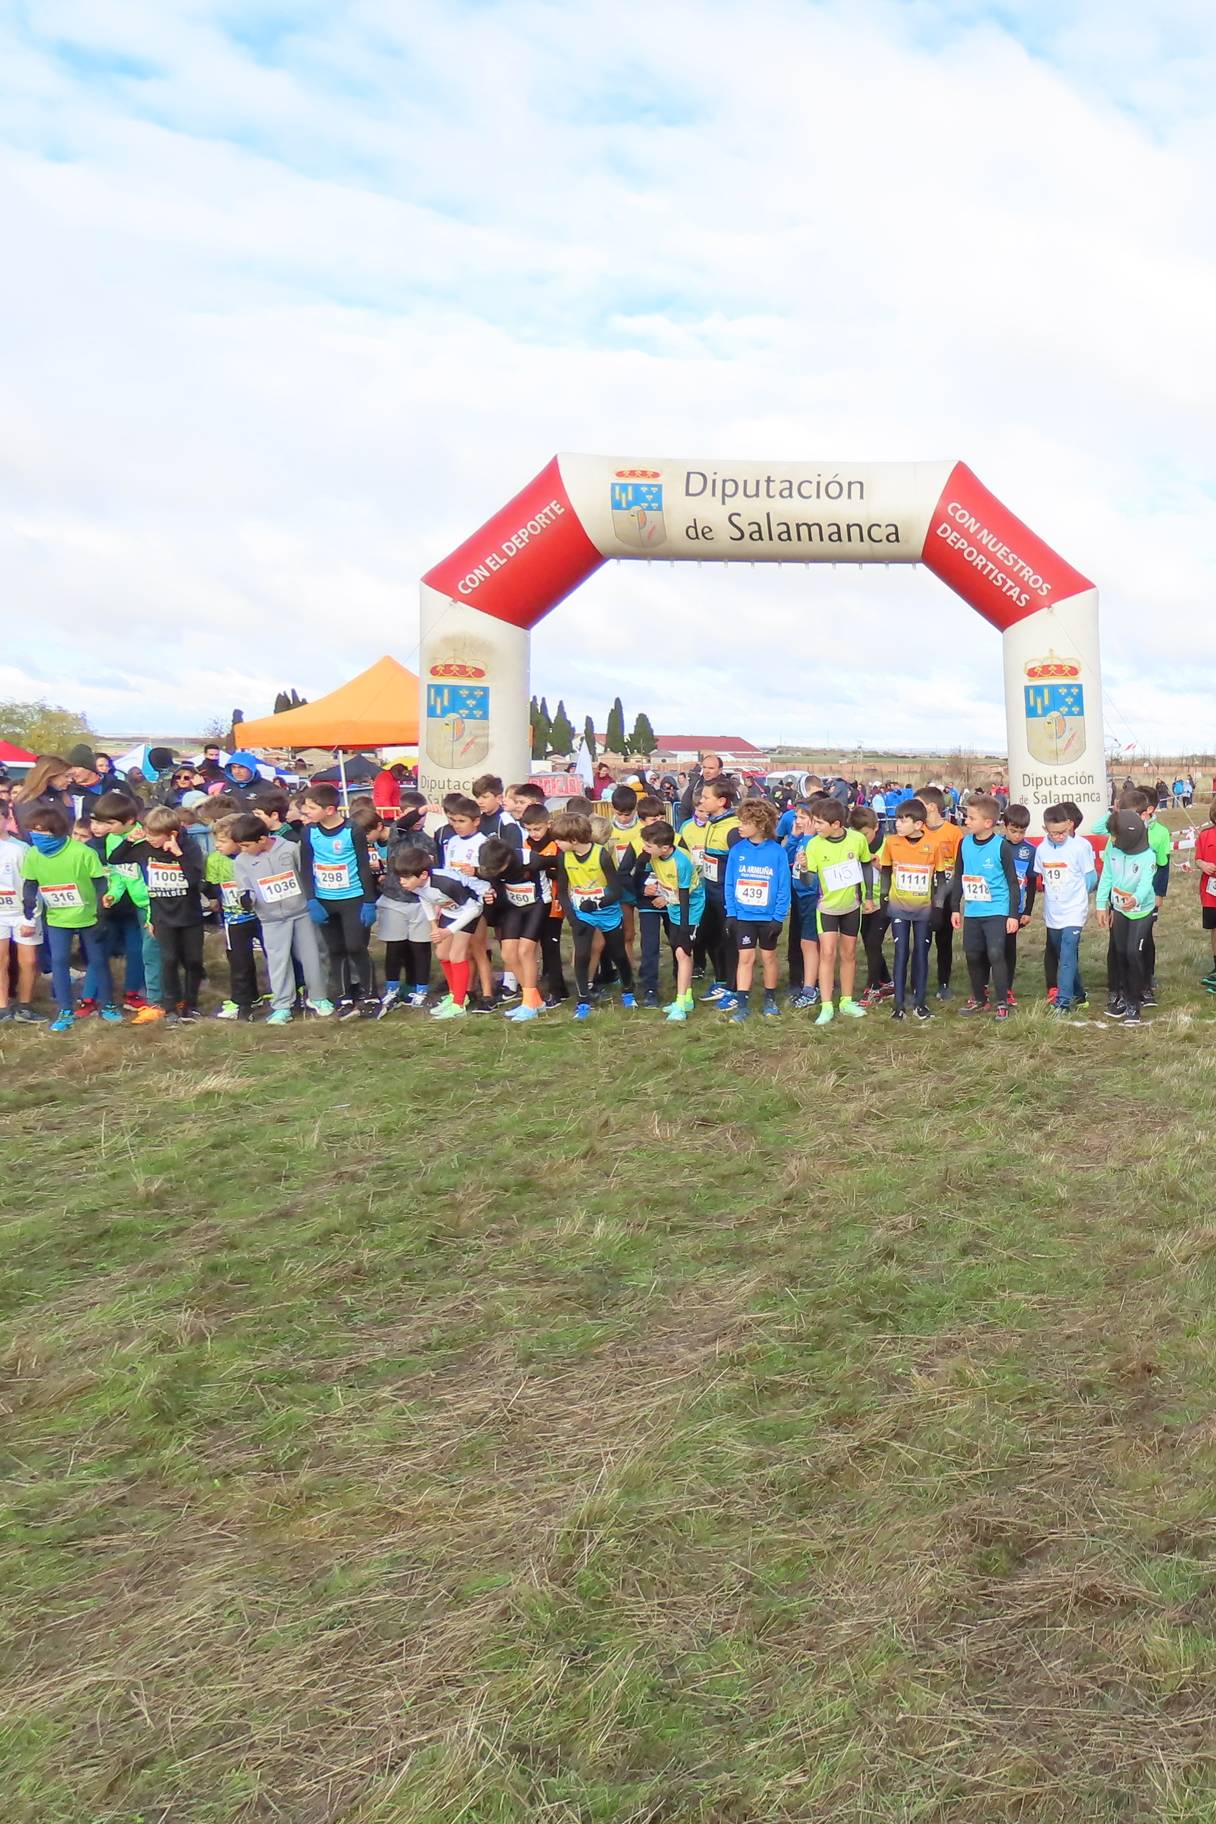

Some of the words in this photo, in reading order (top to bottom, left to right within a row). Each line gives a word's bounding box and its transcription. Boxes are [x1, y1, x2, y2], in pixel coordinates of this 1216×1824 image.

[684, 471, 865, 506] Diputación
[685, 518, 715, 541] de
[727, 512, 901, 544] Salamanca
[457, 564, 491, 595] CON
[484, 552, 508, 571] EL
[501, 499, 566, 557] DEPORTE
[947, 502, 981, 534] CON
[976, 528, 1052, 596] NUESTROS
[936, 522, 1031, 607] DEPORTISTAS
[1022, 770, 1094, 789] Diputación
[1033, 790, 1101, 805] Salamanca
[154, 872, 184, 882] 1005
[321, 872, 343, 882] 298
[900, 873, 927, 885] 1111
[266, 878, 297, 895] 1036
[742, 888, 763, 899] 439
[51, 892, 75, 903] 316
[509, 893, 530, 903] 260
